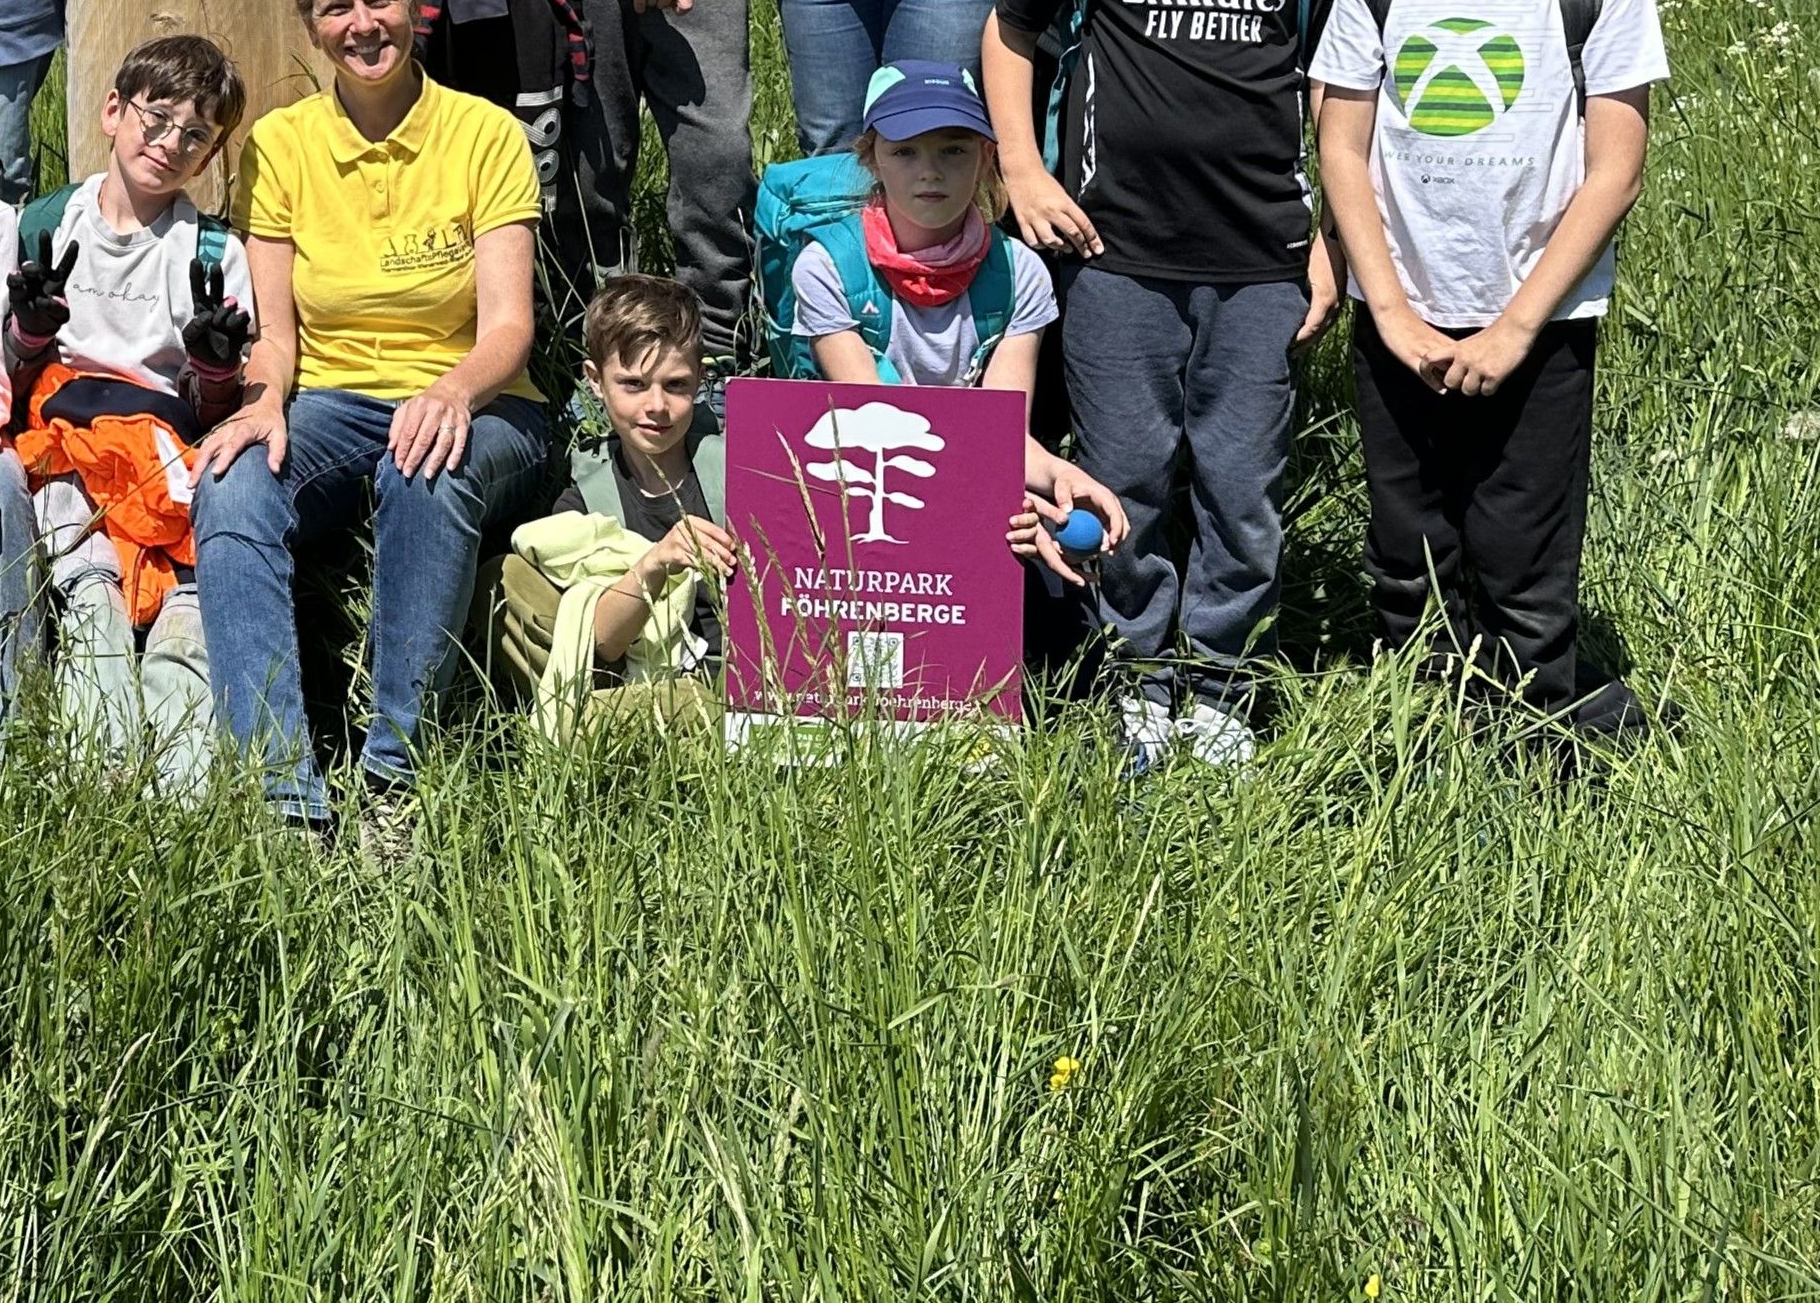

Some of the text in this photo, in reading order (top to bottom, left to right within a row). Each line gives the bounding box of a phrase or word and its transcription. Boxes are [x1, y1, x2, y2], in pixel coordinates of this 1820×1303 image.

[1144, 9, 1263, 43] FLY BETTER
[1416, 154, 1455, 166] YOUR
[1464, 156, 1535, 167] DREAMS
[72, 282, 160, 313] am okay
[793, 566, 954, 596] NATURPARK
[781, 593, 967, 625] FÖHRENBERGE
